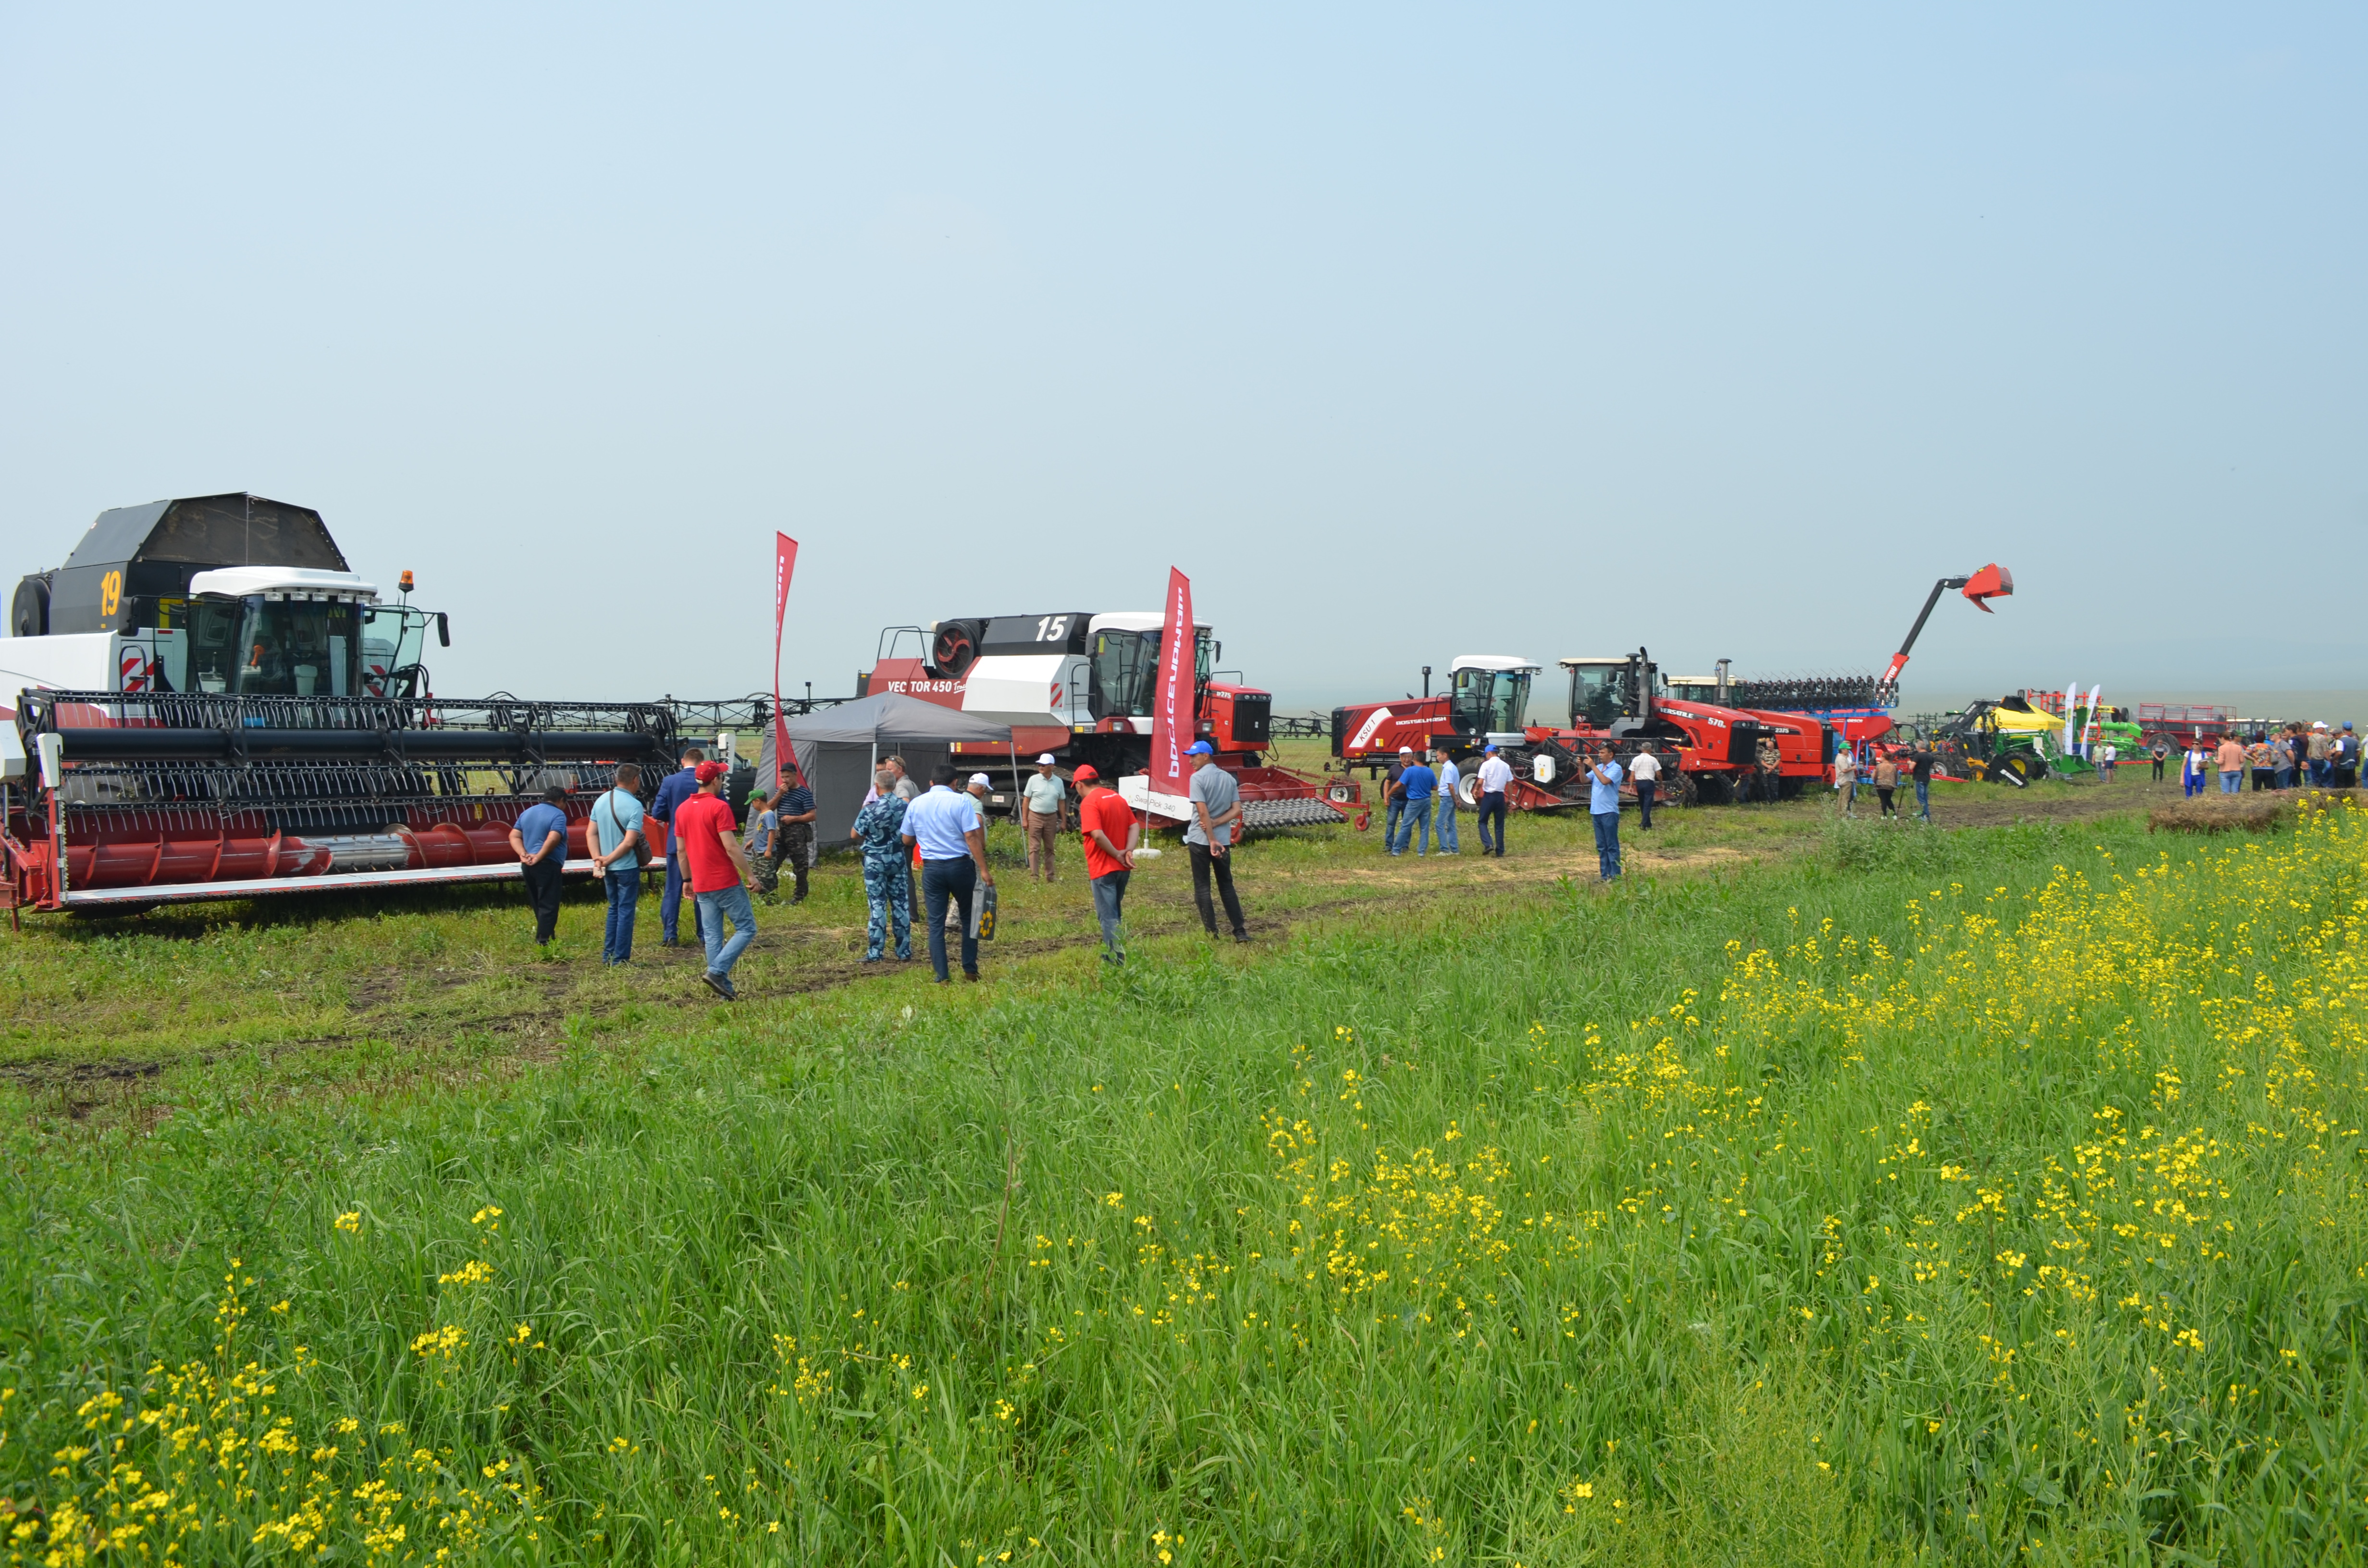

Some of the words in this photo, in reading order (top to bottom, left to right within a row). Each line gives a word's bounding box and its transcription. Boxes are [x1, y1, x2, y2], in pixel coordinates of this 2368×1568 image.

[101, 570, 121, 616] 19
[1036, 616, 1068, 641] 15
[932, 681, 952, 692] 450
[1395, 716, 1447, 725] ROSTSELMASH
[1660, 707, 1694, 719] VERSATILE
[1707, 717, 1724, 728] 570
[1359, 724, 1371, 742] KSU
[1163, 803, 1176, 812] 340
